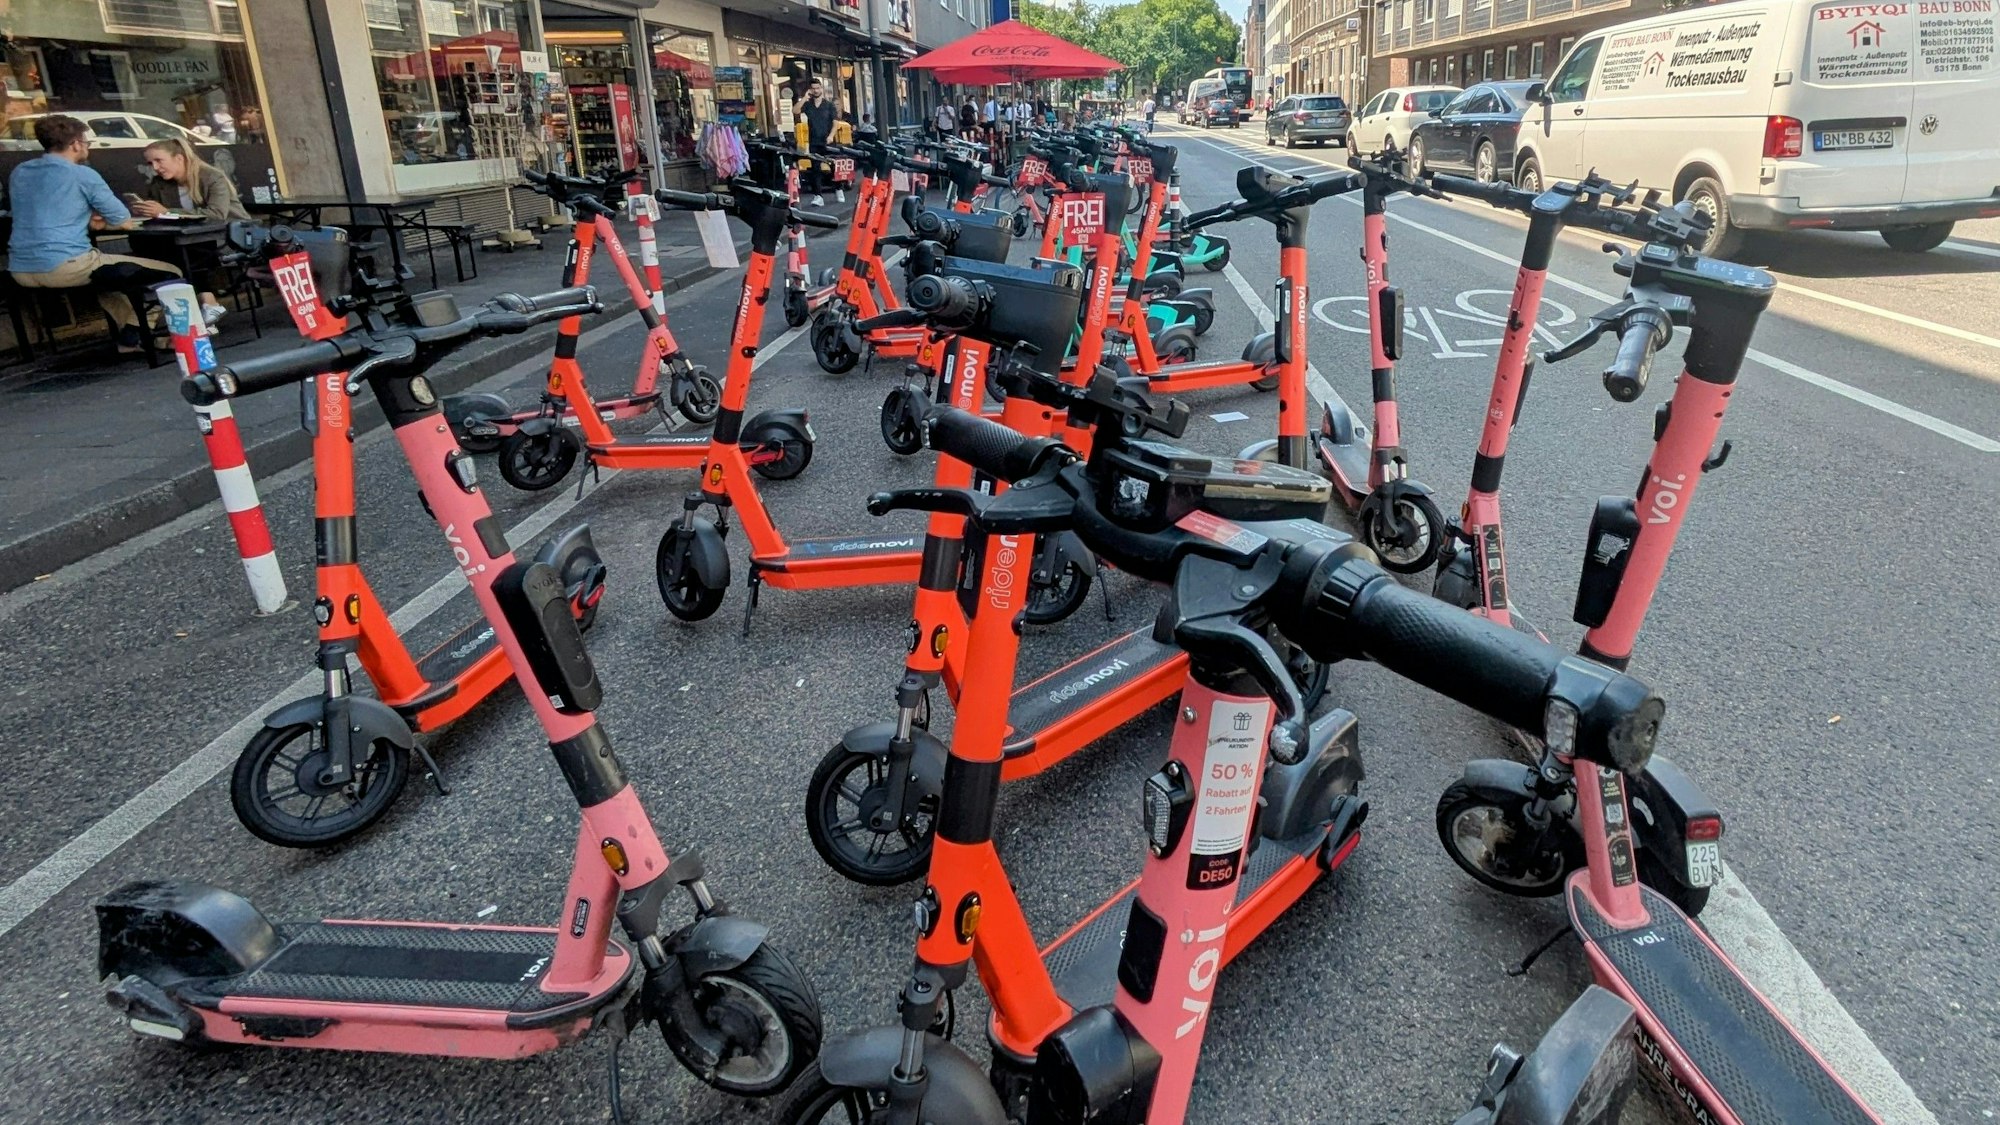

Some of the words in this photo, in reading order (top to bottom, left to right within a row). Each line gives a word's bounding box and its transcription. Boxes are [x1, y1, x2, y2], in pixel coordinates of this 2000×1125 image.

[1818, 4, 1909, 20] BYTYQI
[1919, 2, 1949, 14] BAU
[1953, 1, 1991, 13] BONN
[1611, 37, 1635, 48] BYTYQI
[1635, 33, 1651, 45] BAU
[1651, 30, 1674, 43] BONN
[1675, 29, 1712, 48] Innenputz
[1716, 21, 1761, 43] Außenputz
[971, 45, 1051, 57] Coca-Cola
[1670, 47, 1753, 67] Wärmedämmung
[1817, 55, 1857, 64] Innenputz
[1865, 51, 1908, 60] Außenputz
[1975, 55, 1990, 63] 106
[185, 60, 209, 73] FAN
[1818, 60, 1908, 72] Wärmedämmung
[1819, 68, 1908, 79] Trockenausbau
[1665, 69, 1747, 88] Trockenausbau
[1823, 134, 1840, 146] BN
[1849, 133, 1865, 145] BB
[1868, 132, 1891, 144] 432
[835, 158, 855, 172] FREI
[1022, 159, 1048, 175] FREI
[1128, 160, 1152, 174] FREI
[1063, 200, 1104, 228] FREI
[1071, 227, 1096, 235] 45MIN
[1368, 259, 1381, 290] voi.
[274, 262, 318, 307] FREI
[322, 373, 342, 428] ridem
[1648, 474, 1686, 524] voi.
[832, 538, 914, 552] ridemovi
[1050, 659, 1130, 704] ridemovi
[1212, 764, 1238, 780] 50
[1241, 763, 1254, 779] %
[1206, 788, 1239, 798] Rabatt
[1240, 786, 1253, 796] auf
[1205, 806, 1212, 815] 2
[1214, 805, 1247, 816] Fahrten
[1692, 845, 1717, 864] 225
[1199, 866, 1233, 883] DE50
[1632, 931, 1665, 946] voi.
[520, 957, 549, 982] voi.
[1634, 1025, 1672, 1080] AHRE
[1674, 1078, 1719, 1125] GRA
